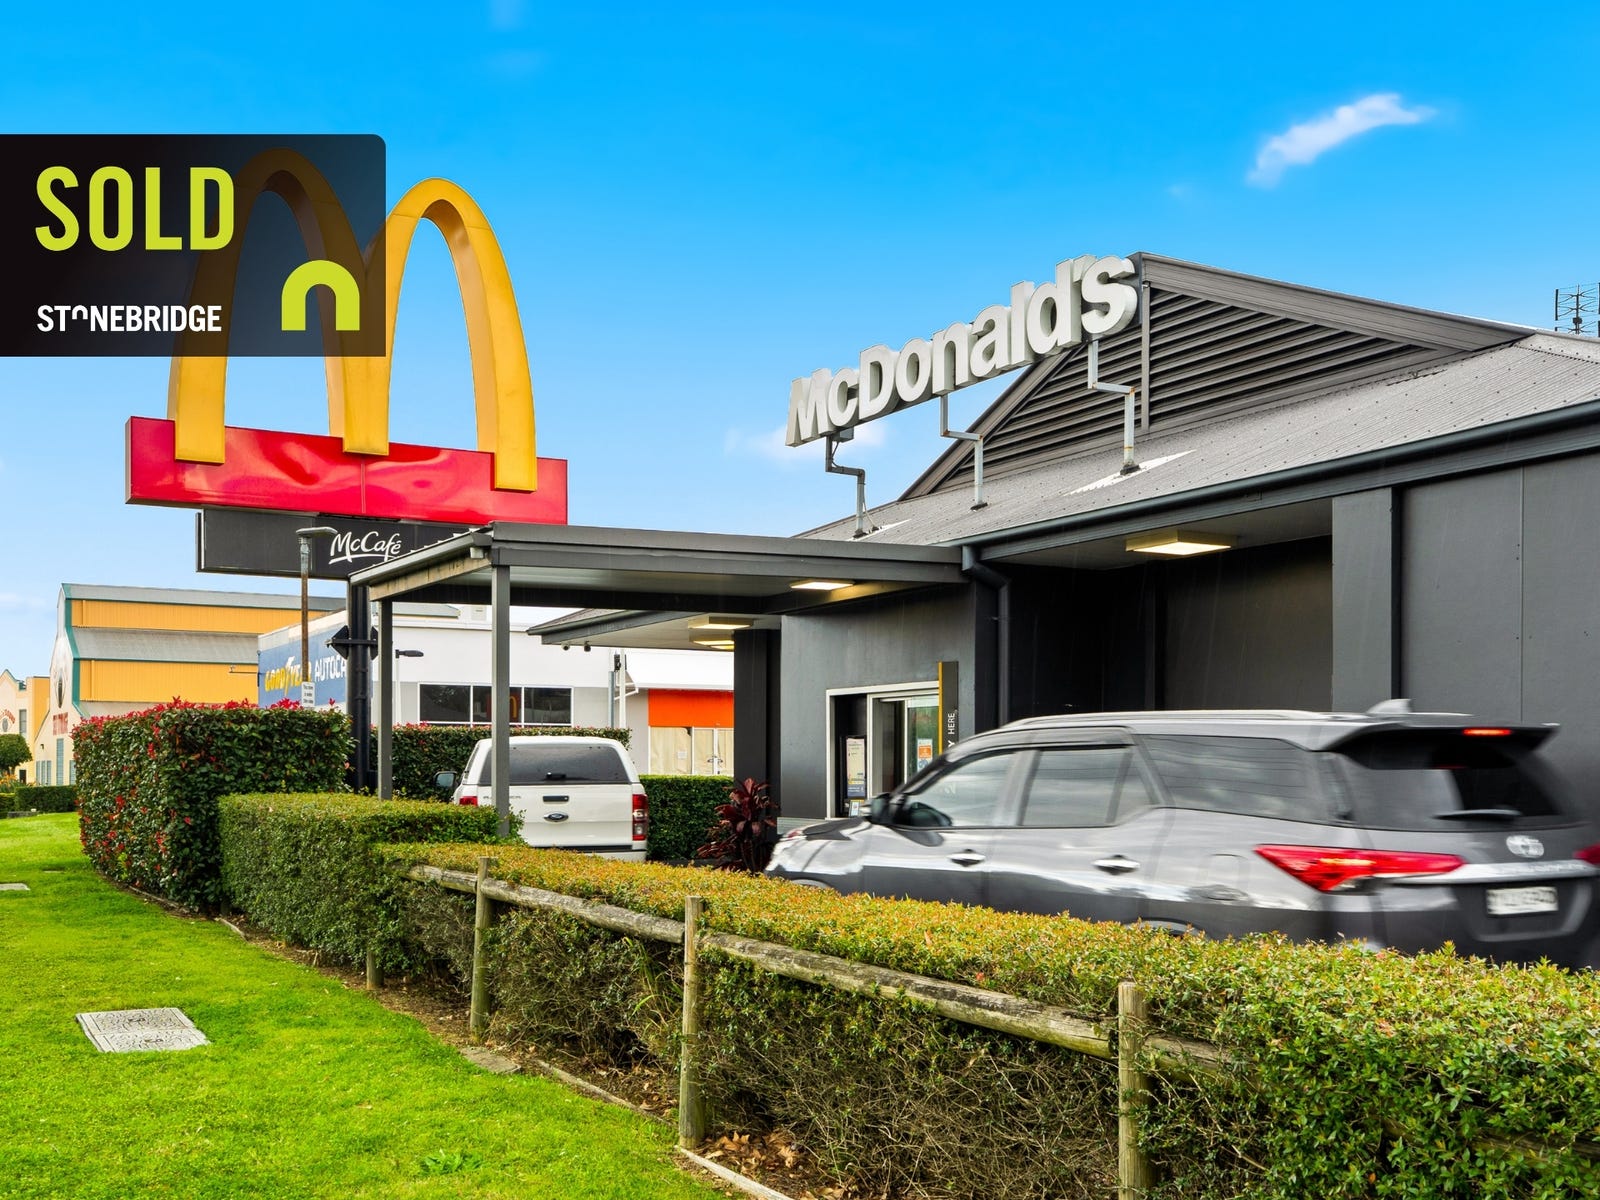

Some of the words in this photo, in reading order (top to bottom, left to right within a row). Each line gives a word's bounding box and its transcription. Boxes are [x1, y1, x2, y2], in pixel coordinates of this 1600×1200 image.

[785, 254, 1138, 447] McDonald's
[330, 531, 402, 563] McCafé
[315, 655, 347, 681] AUTOCA
